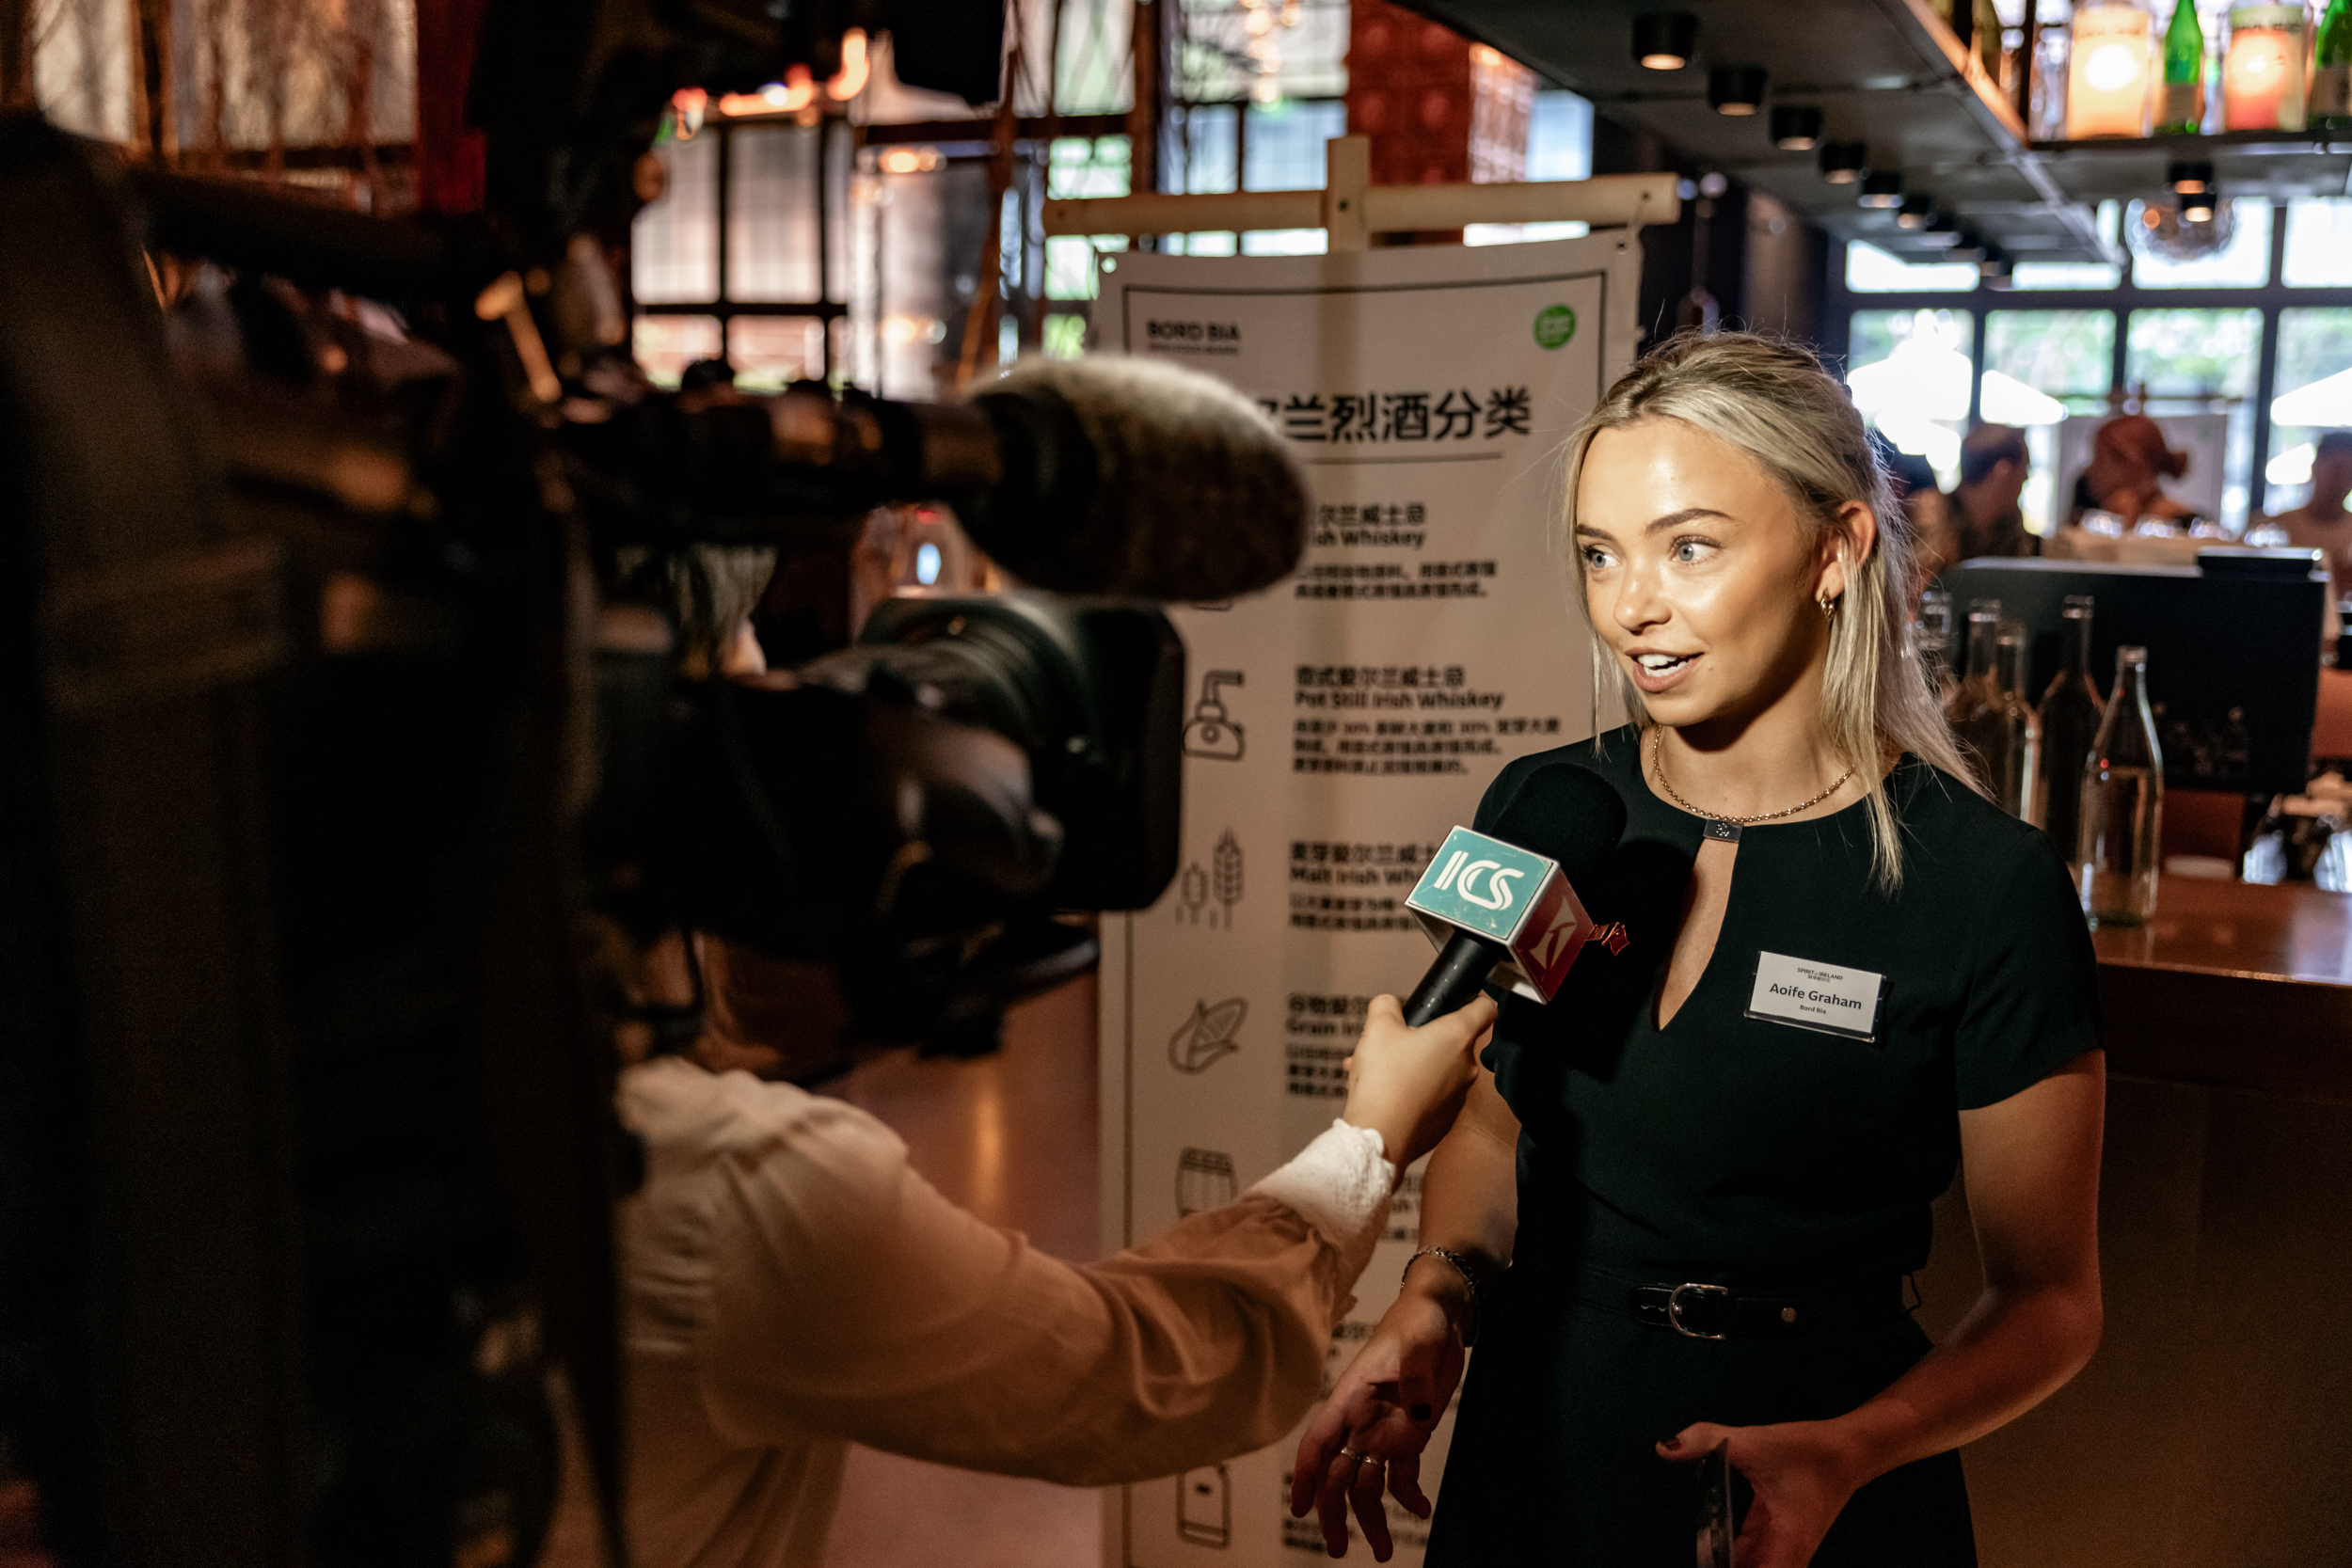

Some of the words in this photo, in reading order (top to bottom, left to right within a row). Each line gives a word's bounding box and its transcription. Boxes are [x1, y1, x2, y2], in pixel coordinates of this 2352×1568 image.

[1147, 320, 1203, 341] BORD
[1340, 531, 1425, 550] Whiskey
[1416, 689, 1503, 712] Whiskey
[1433, 850, 1525, 911] ICS
[1819, 972, 1843, 980] IRELAND
[1770, 983, 1805, 999] Aoife
[1808, 990, 1862, 1010] Graham
